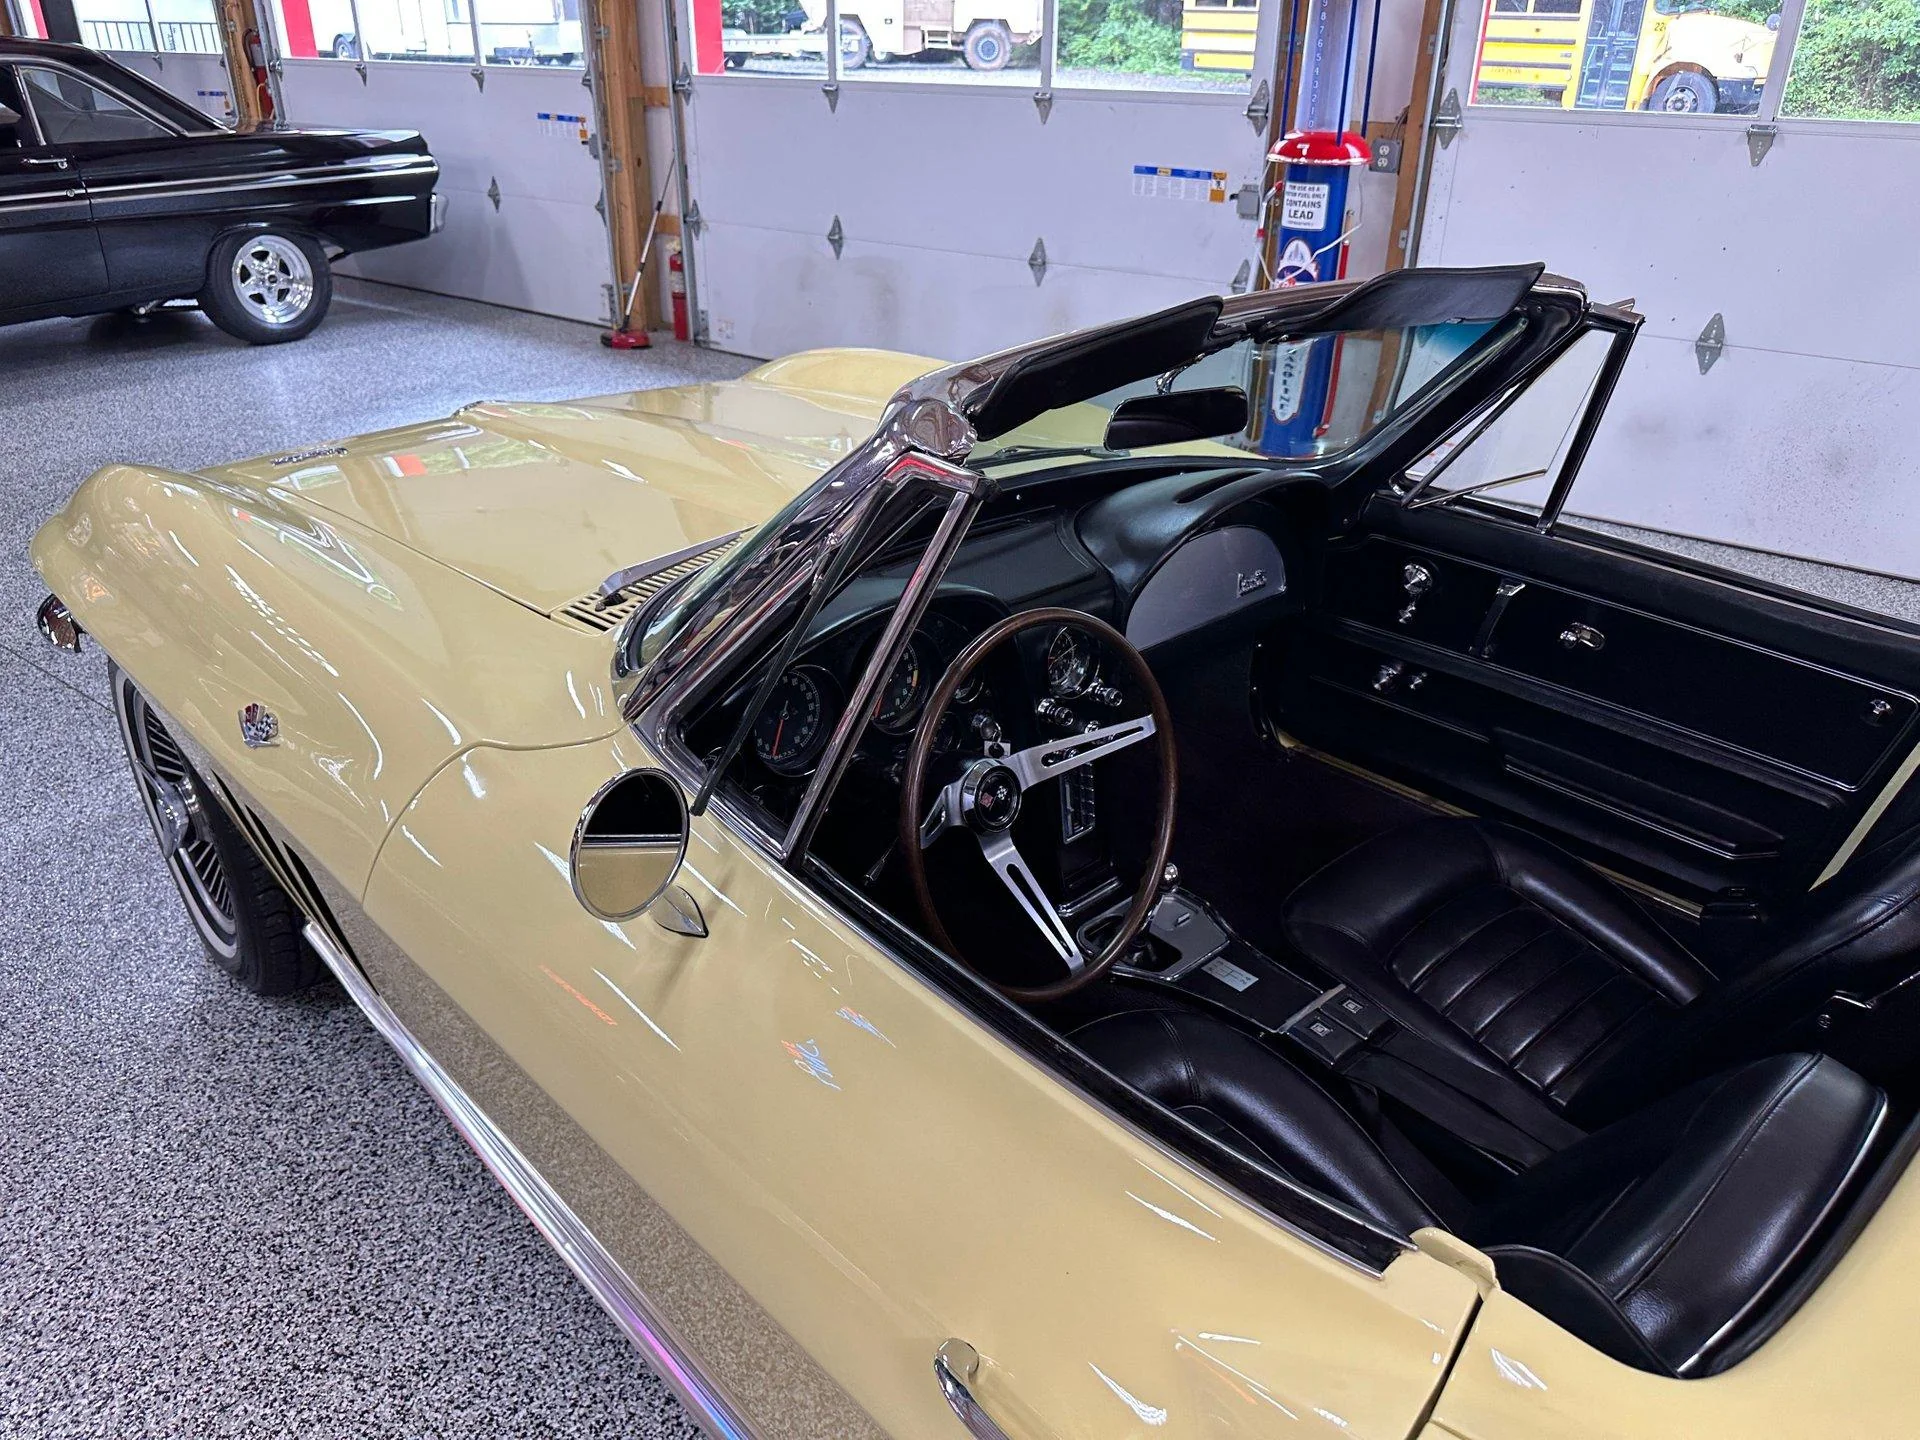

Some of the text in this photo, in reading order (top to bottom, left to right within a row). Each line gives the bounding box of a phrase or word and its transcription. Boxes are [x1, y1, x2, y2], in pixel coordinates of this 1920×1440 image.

[1321, 12, 1327, 21] 8
[1319, 26, 1325, 34] 7
[1318, 39, 1324, 48] 6
[1316, 53, 1322, 62] 5
[1314, 67, 1320, 75] 4
[1313, 80, 1319, 89] 3
[1311, 94, 1318, 102] 2
[1286, 199, 1321, 209] CONTAINS
[1288, 209, 1314, 220] LEAD
